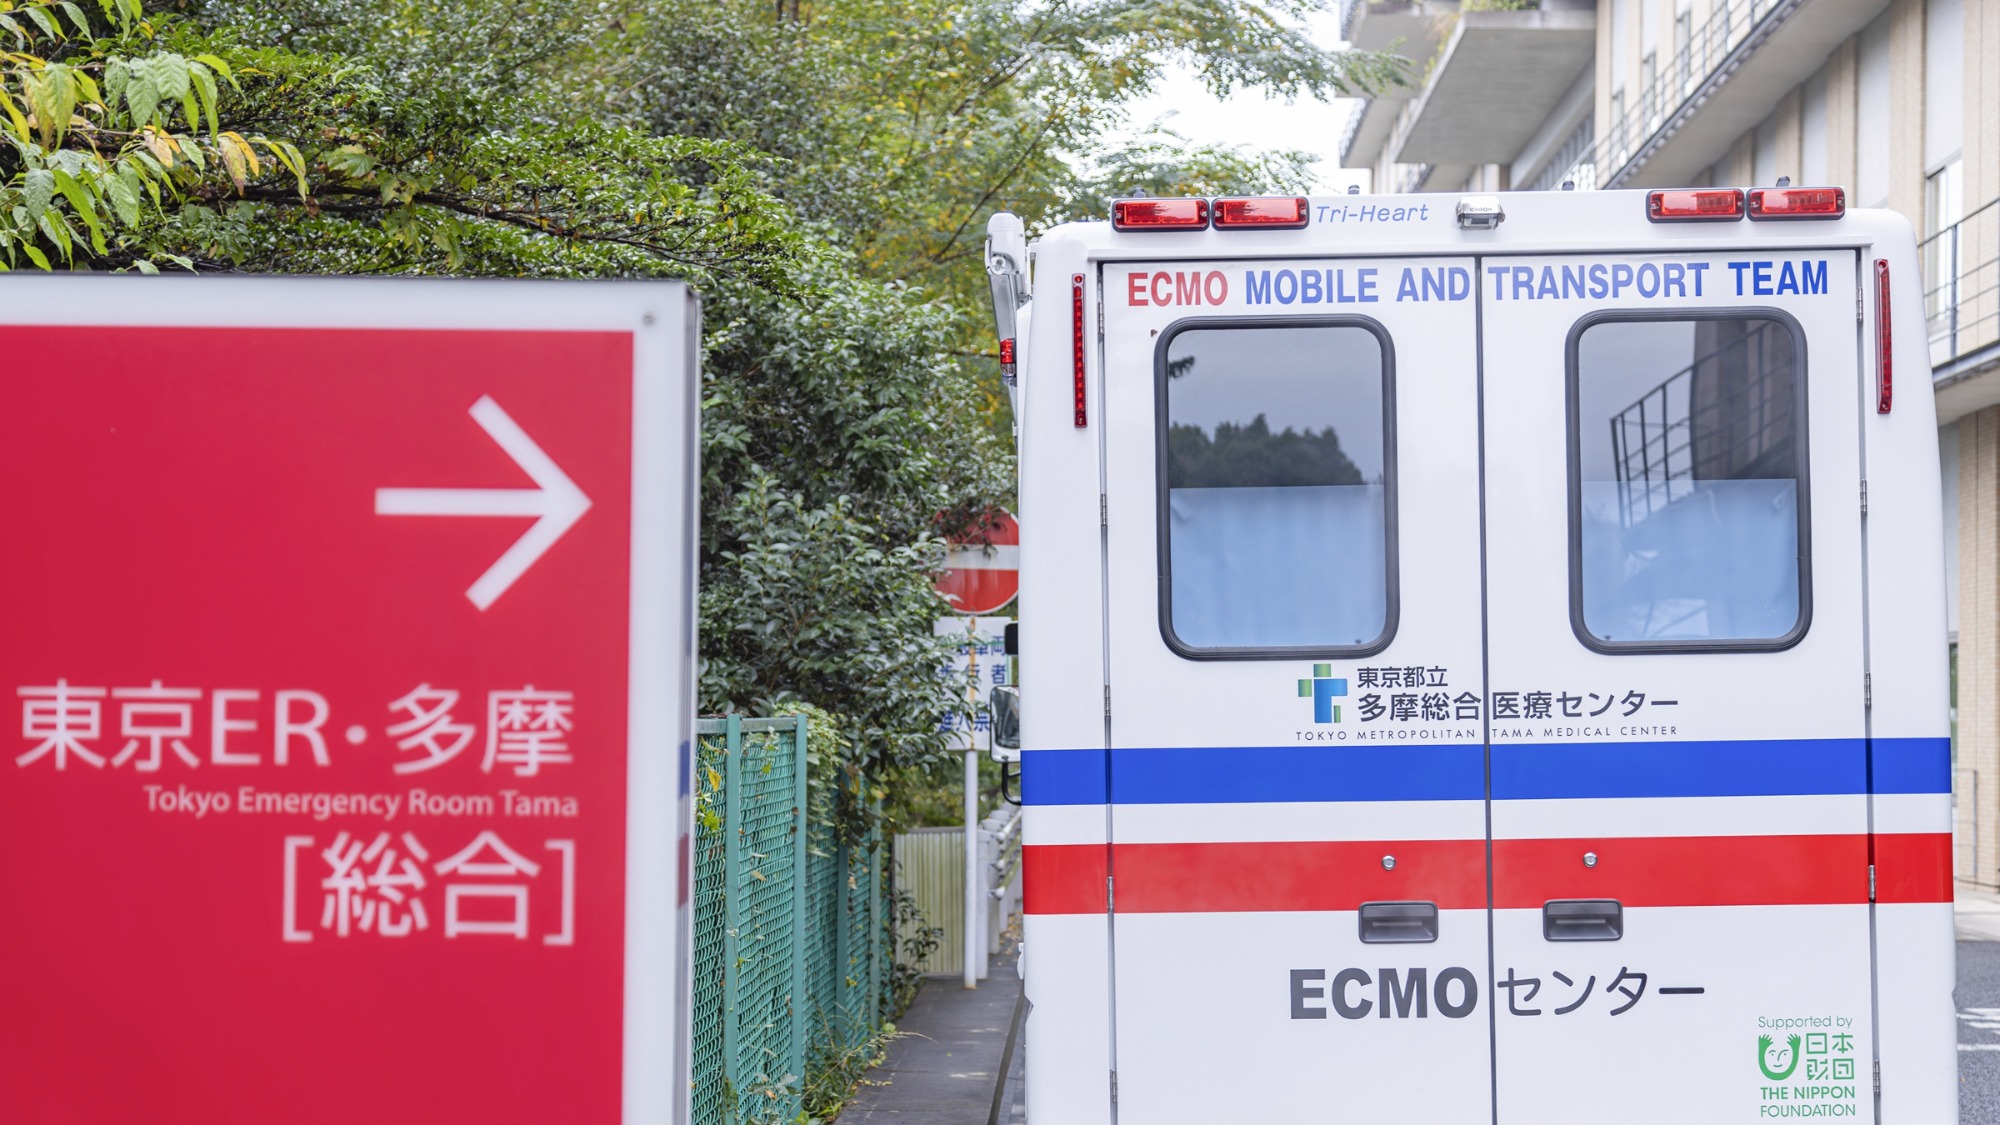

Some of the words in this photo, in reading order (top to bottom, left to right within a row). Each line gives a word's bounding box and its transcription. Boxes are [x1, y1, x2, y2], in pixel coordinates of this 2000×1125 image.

[1316, 204, 1429, 223] Tri-Heart
[1128, 270, 1228, 307] ECMO
[1245, 268, 1379, 305] MOBILE
[1396, 266, 1471, 302] AND
[1487, 262, 1710, 301] TRANSPORT
[1728, 260, 1828, 297] TEAM
[1357, 665, 1449, 689] 東京都立
[15, 679, 574, 777] 東京ER・多摩
[1296, 730, 1347, 741] TOKYO
[1357, 729, 1475, 740] METROPOLITAN
[1491, 728, 1534, 738] TAMA
[1543, 726, 1611, 737] MEDICAL
[1620, 725, 1677, 736] CENTER
[145, 785, 231, 818] Tokyo
[237, 786, 401, 821] Emergency
[409, 788, 494, 816] Room
[502, 790, 578, 817] Tama
[282, 830, 575, 946] [総合]
[1758, 1015, 1832, 1030] Supported
[1836, 1015, 1853, 1029] by
[1806, 1032, 1854, 1055] 日本
[1760, 1087, 1789, 1101] THE
[1794, 1085, 1855, 1100] NIPPON
[1760, 1103, 1856, 1118] FOUNDATION
